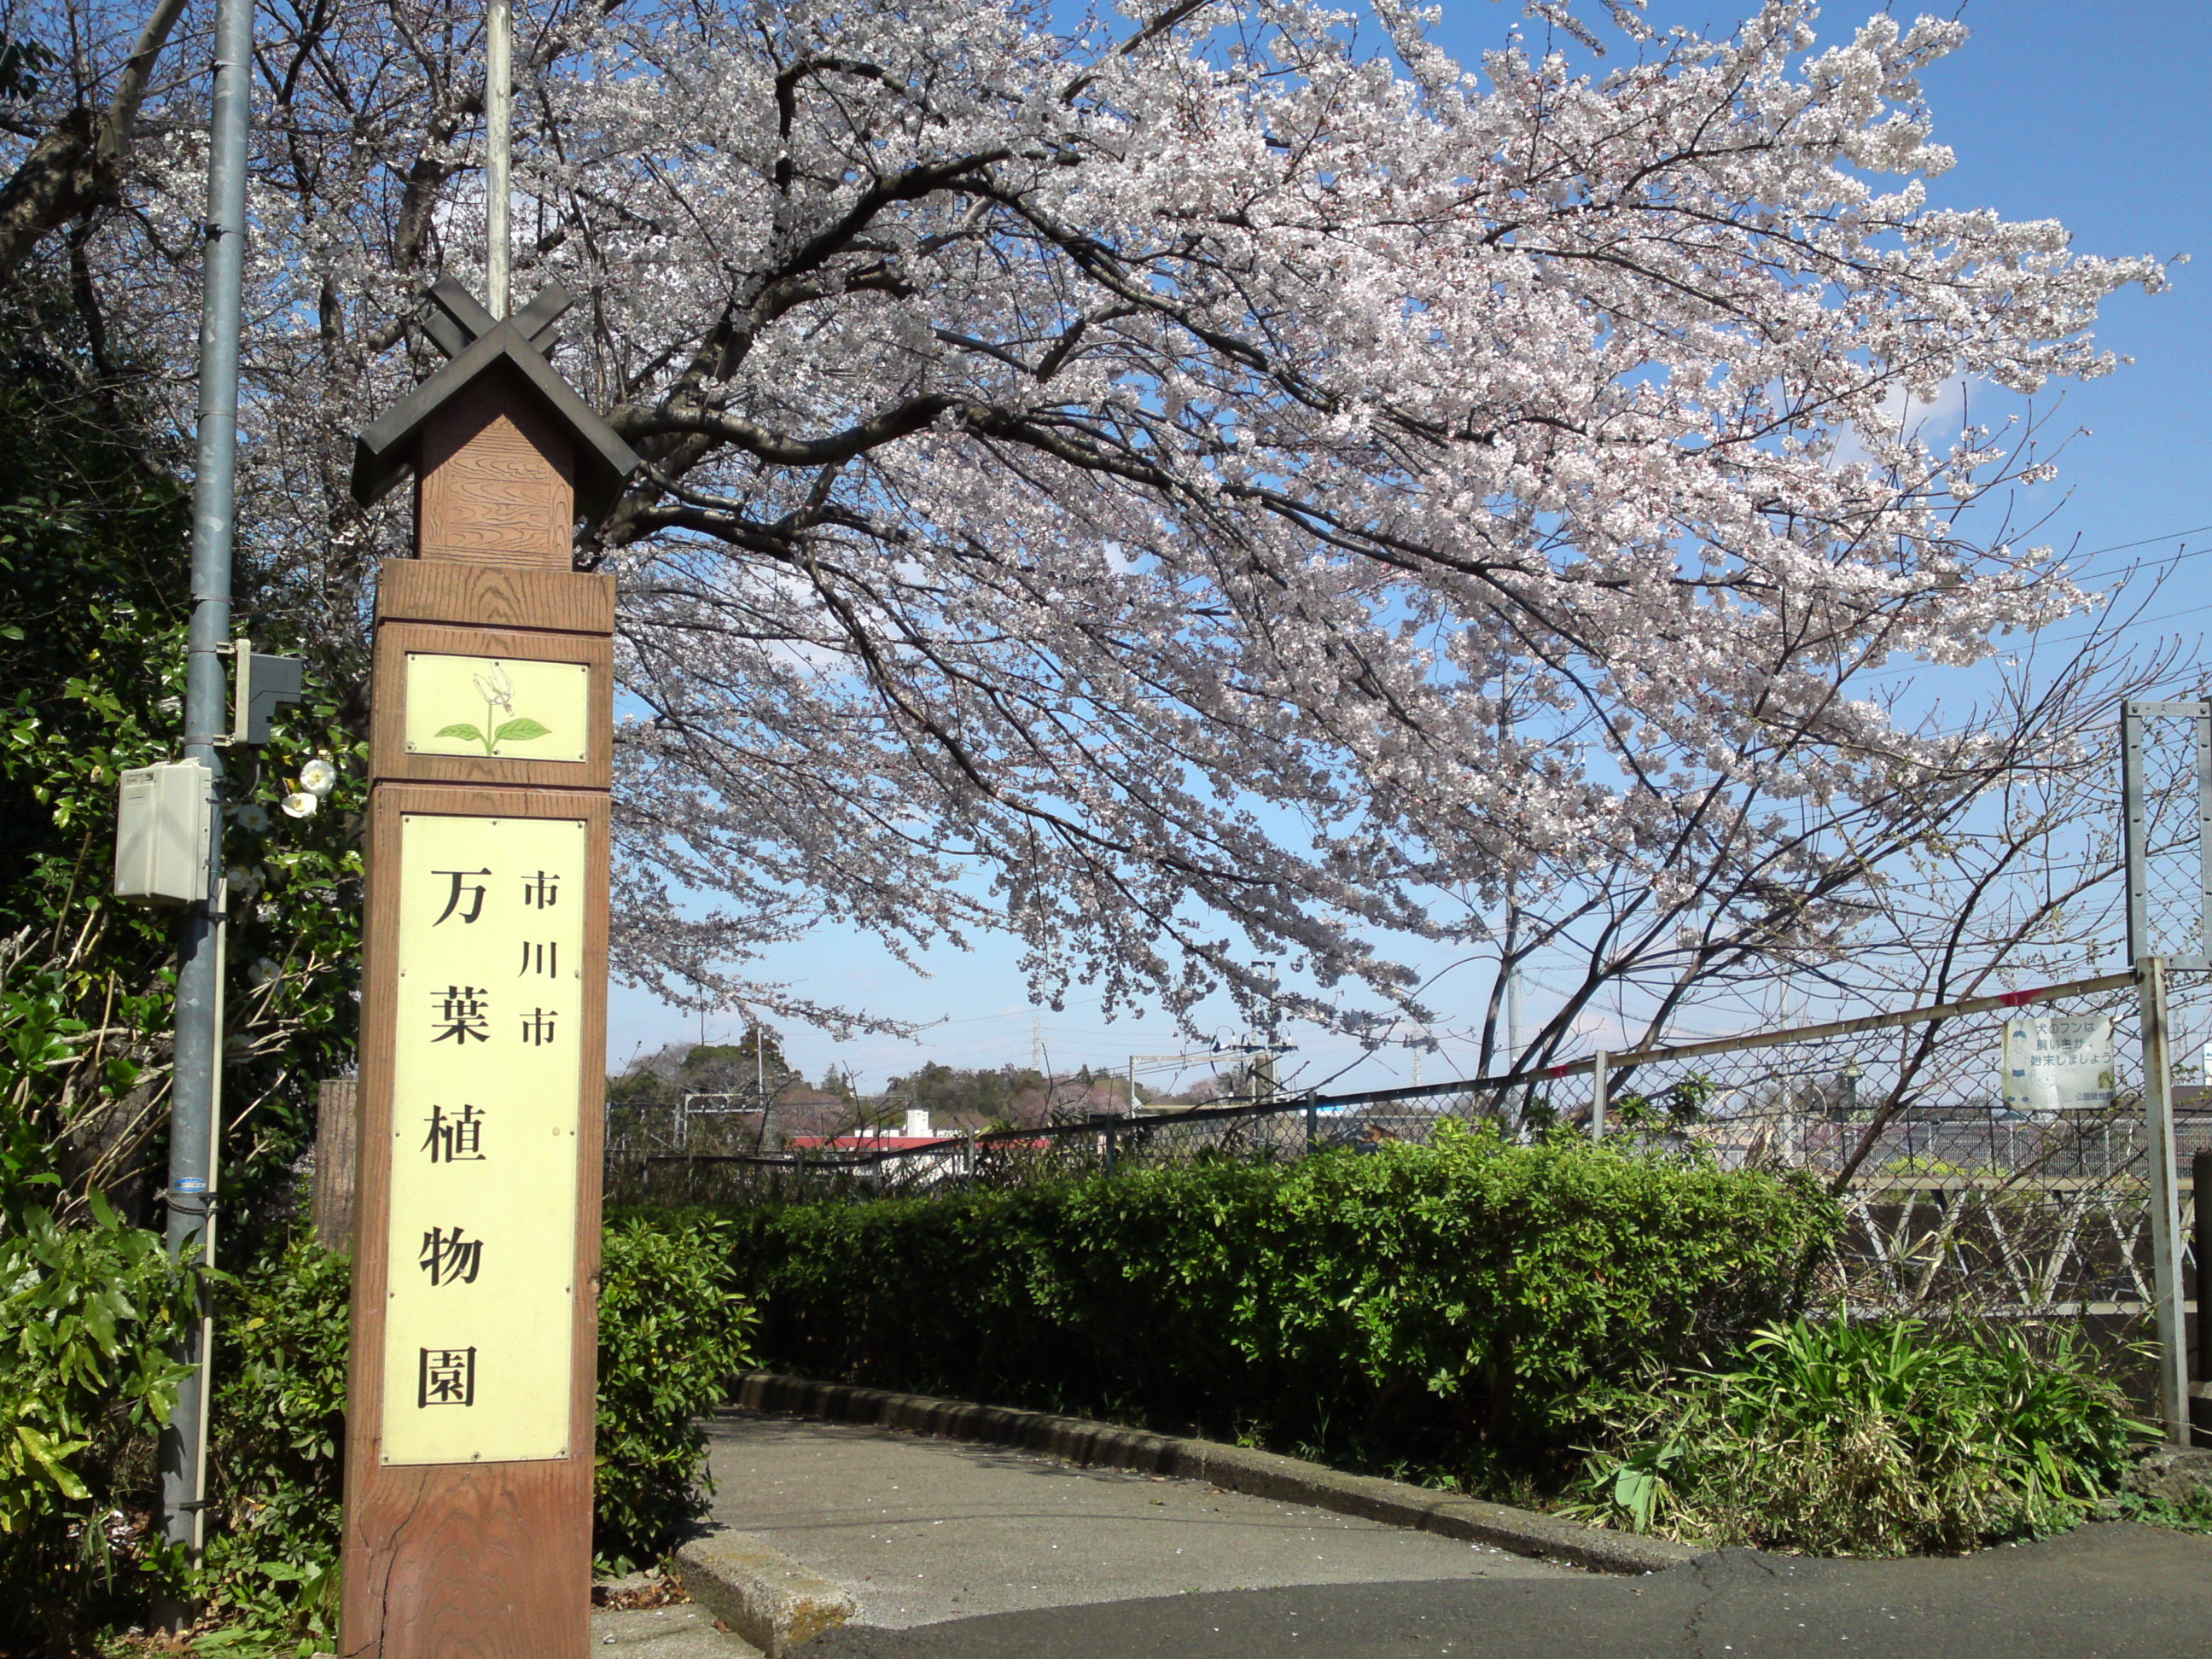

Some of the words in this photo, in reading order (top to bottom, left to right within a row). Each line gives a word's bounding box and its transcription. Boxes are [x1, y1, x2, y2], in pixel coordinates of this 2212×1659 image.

[517, 869, 561, 1047] 市川市
[2035, 1022, 2096, 1035] 犬のフンは
[2036, 1038, 2084, 1051] 飼い主が
[2030, 1051, 2112, 1067] 始末しましょう
[416, 867, 492, 1409] 万葉植物園
